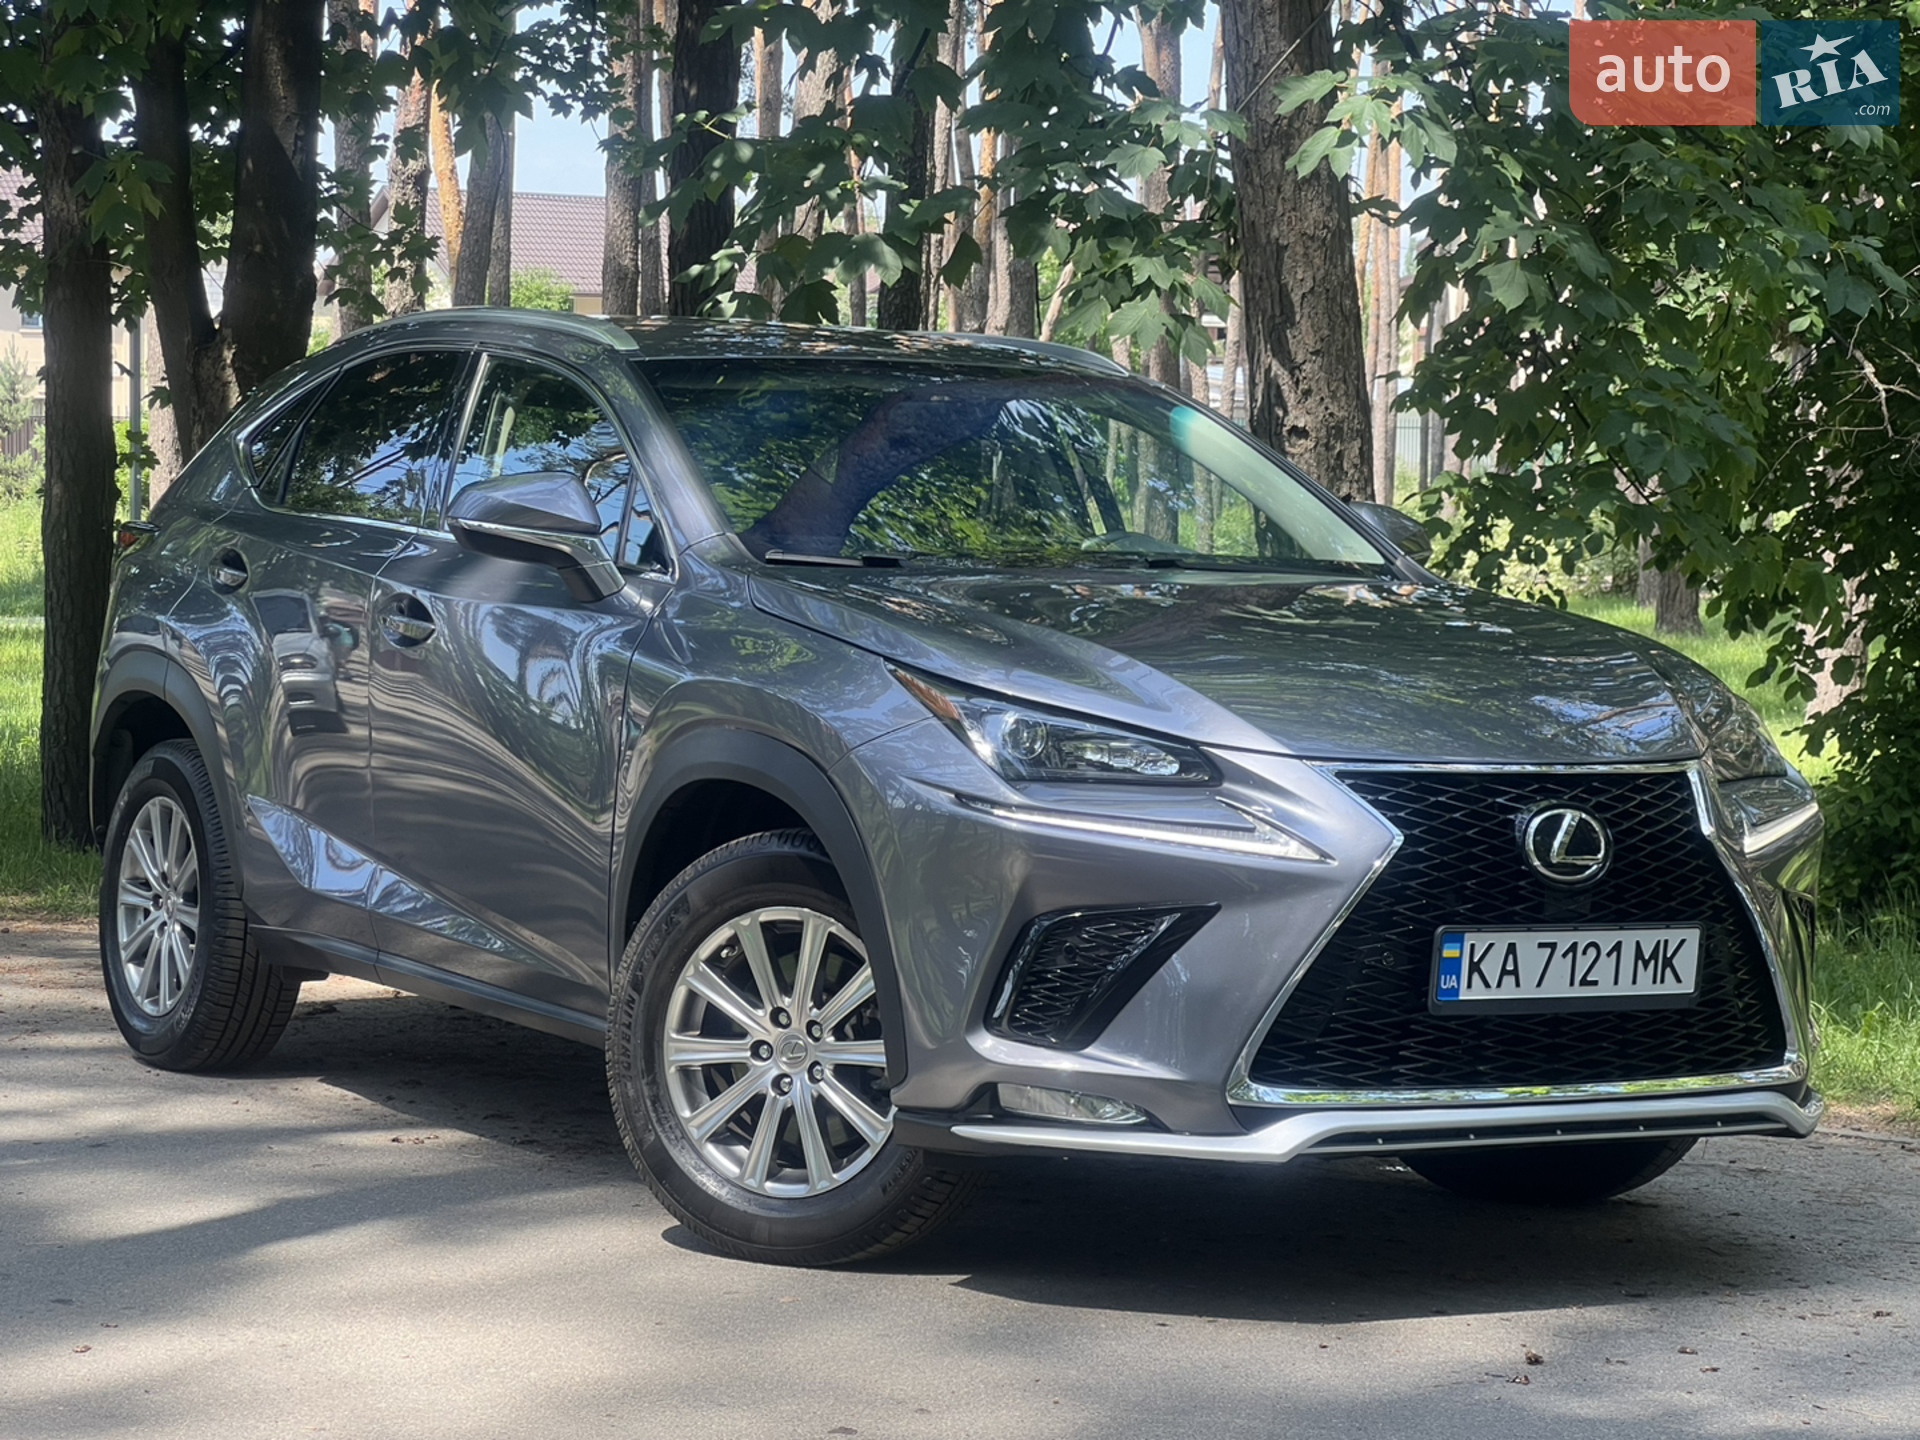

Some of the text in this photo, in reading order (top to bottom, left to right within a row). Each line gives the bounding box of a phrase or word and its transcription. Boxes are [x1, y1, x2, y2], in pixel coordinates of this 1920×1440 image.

[1466, 938, 1688, 989] KA 7121 MK
[1441, 974, 1458, 989] UA
